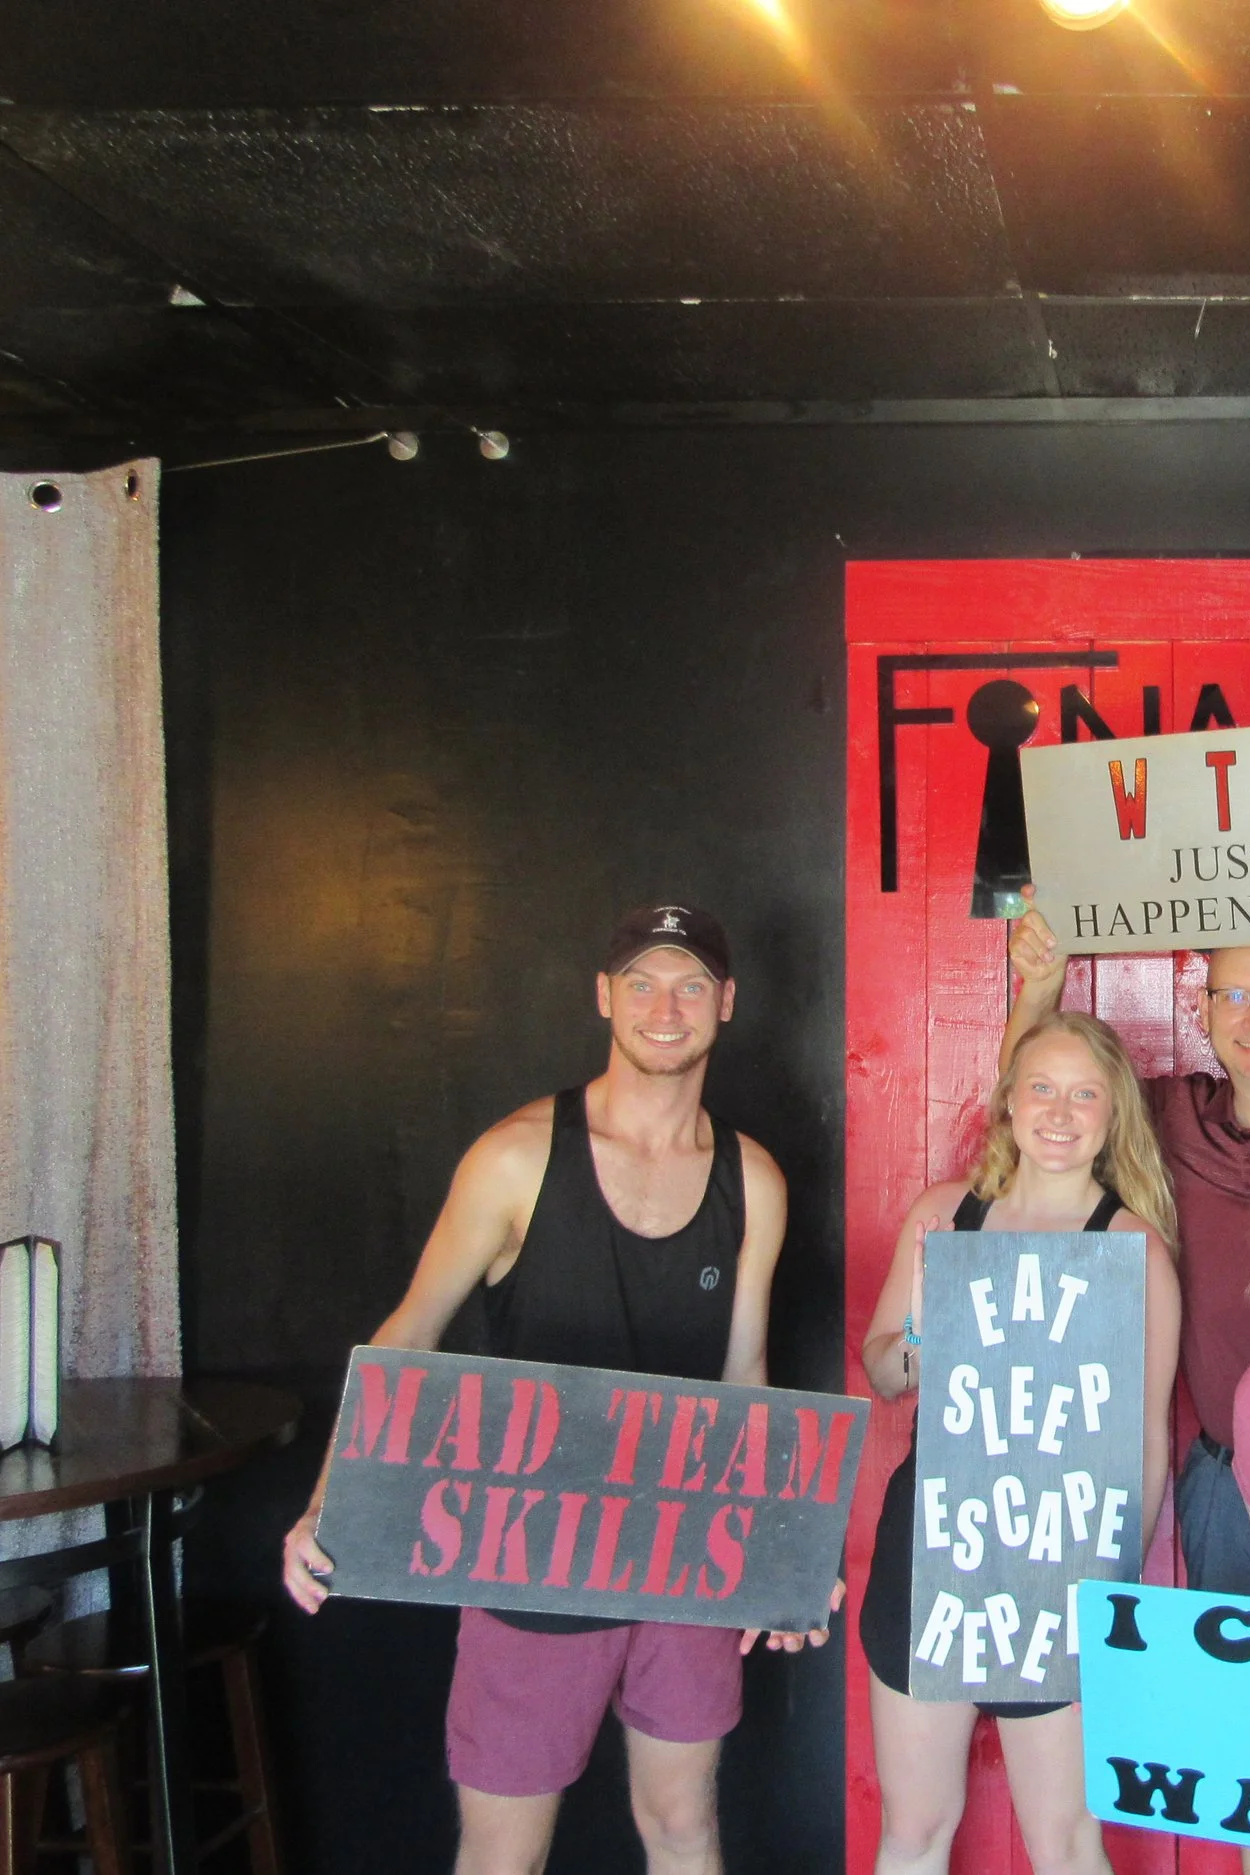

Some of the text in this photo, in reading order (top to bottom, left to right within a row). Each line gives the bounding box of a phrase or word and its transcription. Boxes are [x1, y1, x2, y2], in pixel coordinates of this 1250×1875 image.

[969, 1253, 1089, 1347] EAT
[340, 1363, 856, 1505] MAD TEAM
[942, 1362, 1111, 1457] SLEEP
[408, 1479, 755, 1600] SKILLS
[923, 1470, 1129, 1572] ESCAPE
[915, 1583, 1080, 1684] REPE
[1104, 1593, 1148, 1652] I
